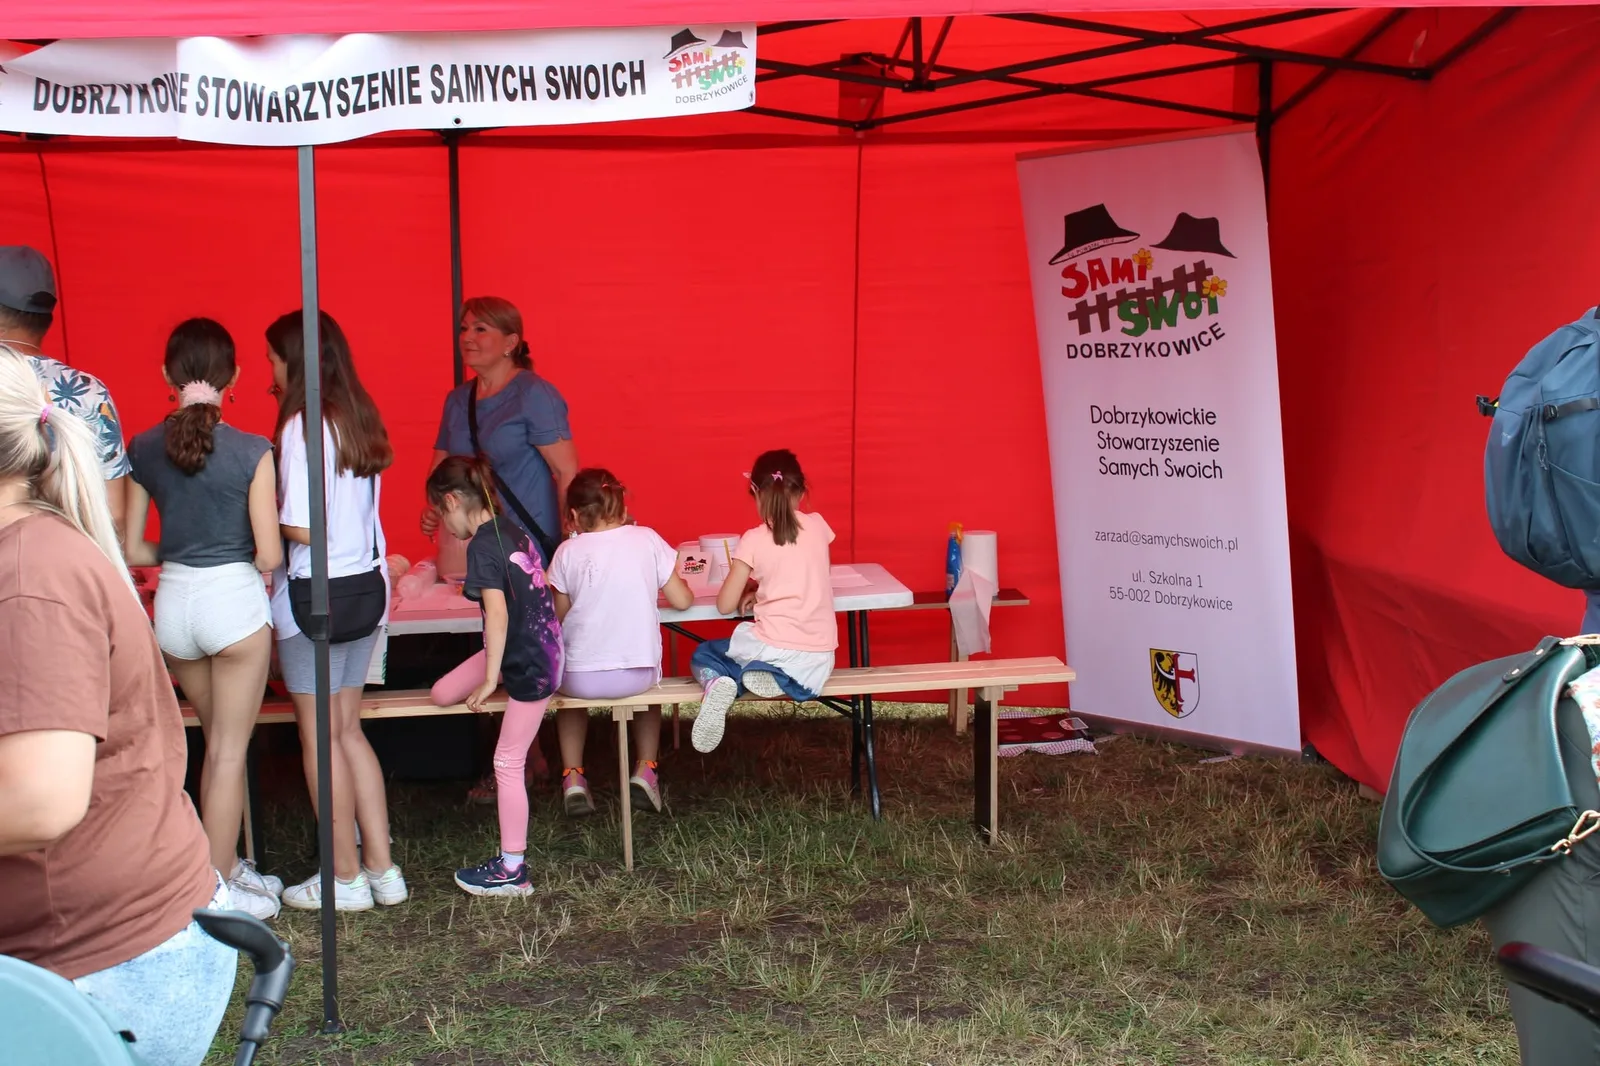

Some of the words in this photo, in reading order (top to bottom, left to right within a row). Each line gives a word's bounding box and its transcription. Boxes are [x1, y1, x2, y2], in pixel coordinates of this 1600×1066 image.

[195, 63, 423, 123] STOWARZYSZENIE
[430, 64, 538, 105] SAMYCH
[544, 59, 647, 102] SWOICH
[675, 74, 748, 104] DOBRZYKOWICE
[1066, 321, 1226, 360] DOBRZYKOWICE
[1090, 404, 1217, 429] Dobrzykowickie
[1097, 430, 1220, 455] Stowarzyszenie
[1098, 456, 1159, 480] Samych
[1164, 457, 1223, 480] Swoich
[1094, 529, 1239, 553] zarzad@samychswoich.pl
[1132, 569, 1146, 584] ul.
[1149, 570, 1193, 588] Szkolna
[1196, 574, 1204, 588] 1
[1109, 586, 1151, 604] 55-002
[1155, 590, 1233, 611] Dobrzykowice
